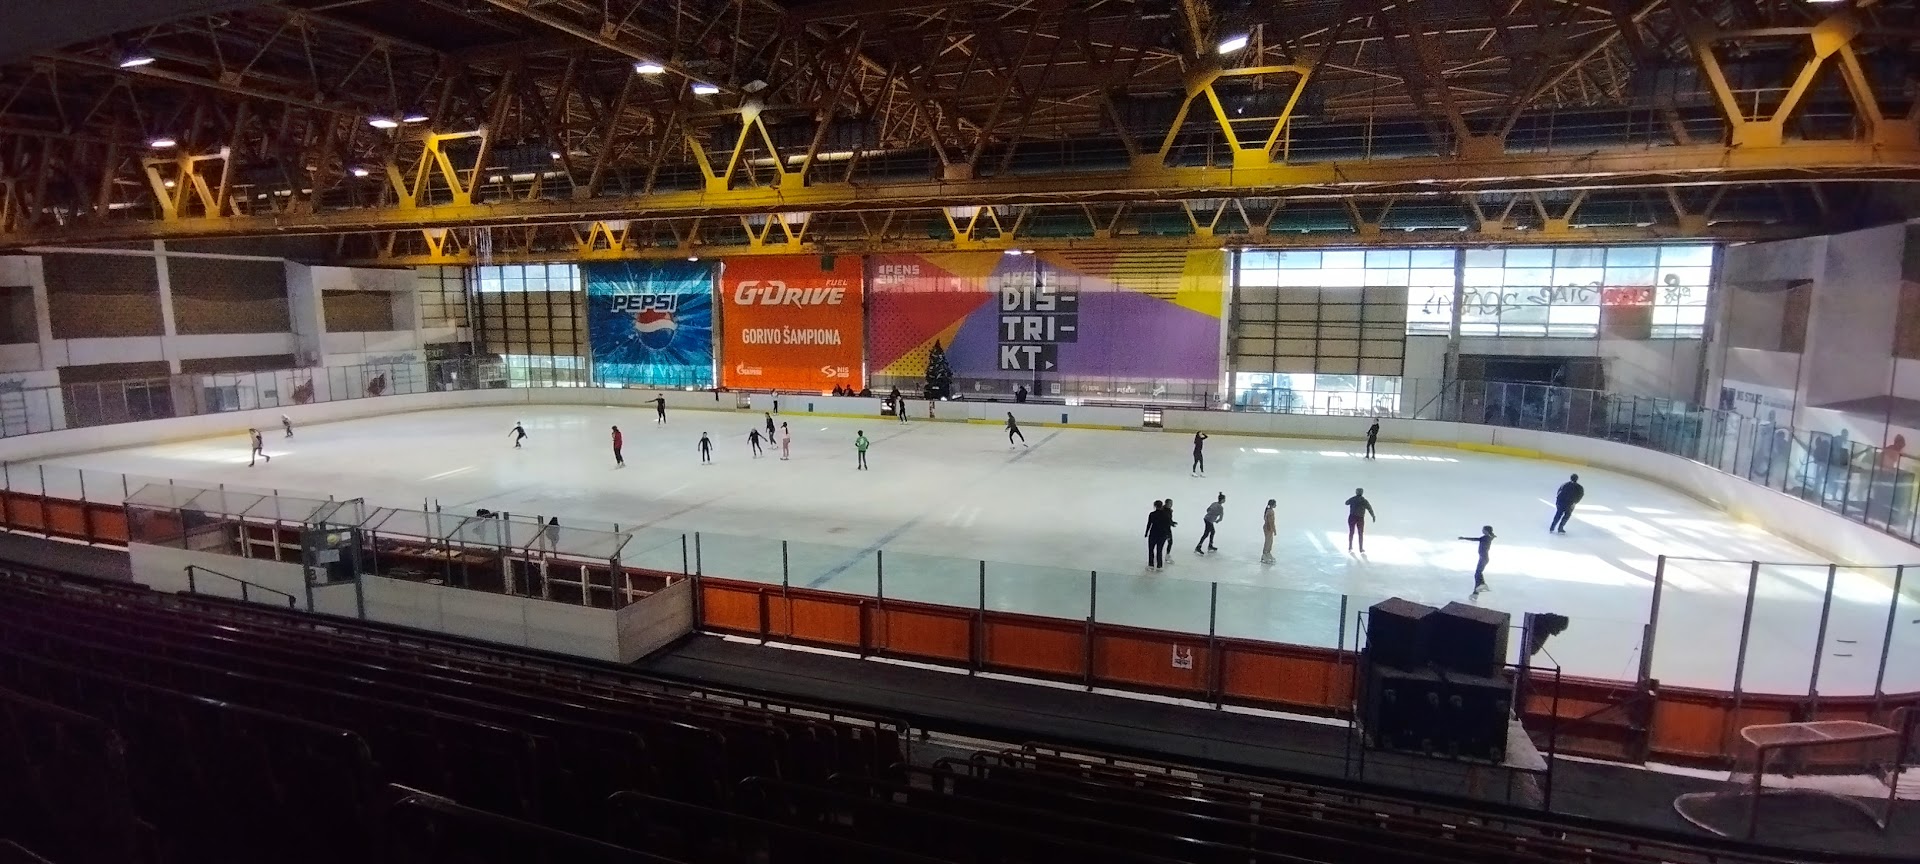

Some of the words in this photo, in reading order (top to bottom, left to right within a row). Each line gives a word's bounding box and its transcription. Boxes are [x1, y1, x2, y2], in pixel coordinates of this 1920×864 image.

[611, 293, 677, 312] PEPSI
[742, 328, 781, 345] GORIVO
[784, 325, 841, 345] ŠAMPIONA
[1001, 346, 1042, 370] KT
